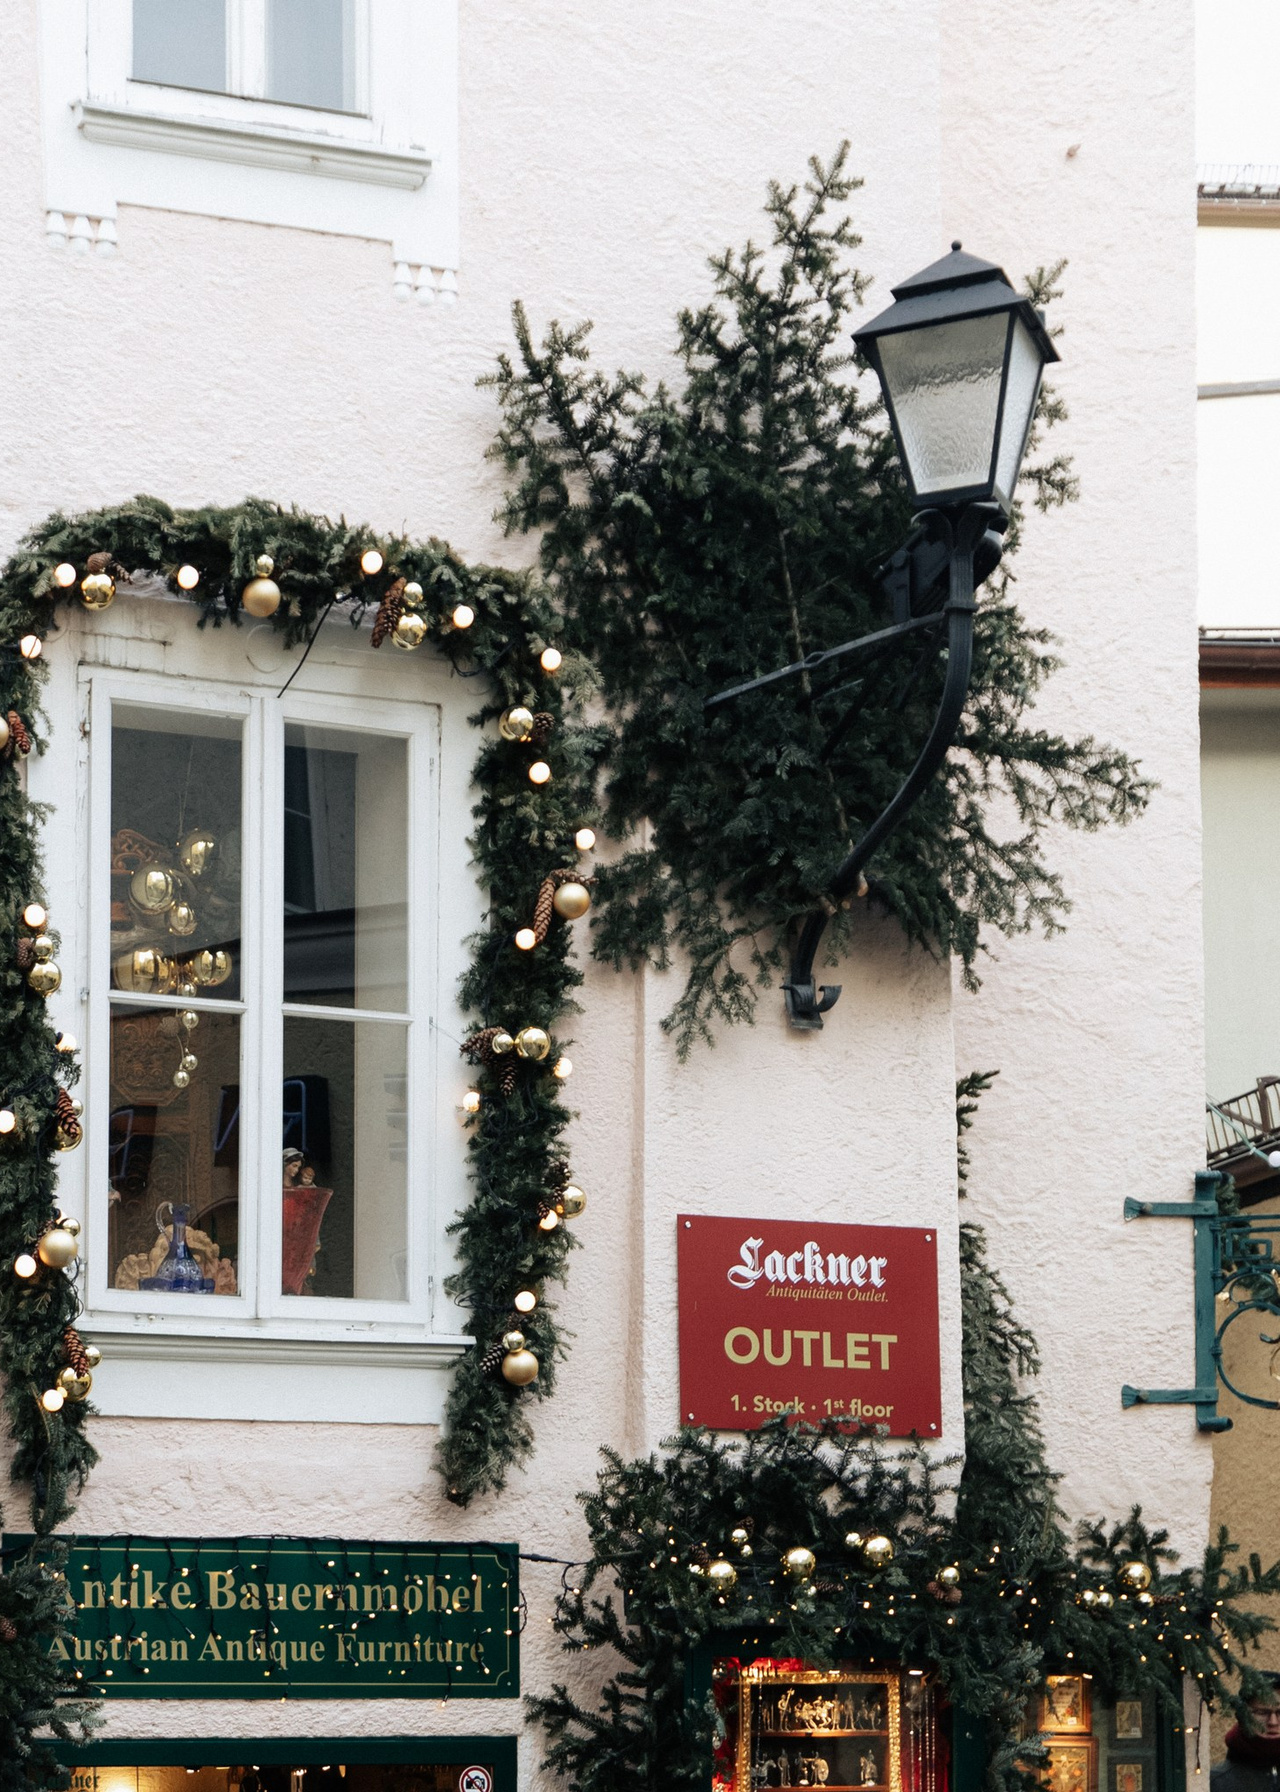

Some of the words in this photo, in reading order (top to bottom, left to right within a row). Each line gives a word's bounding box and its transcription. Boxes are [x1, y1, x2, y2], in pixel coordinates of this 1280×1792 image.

[727, 1237, 888, 1289] Lackner
[766, 1284, 843, 1301] Antiquitäten
[847, 1288, 889, 1303] Outlet.
[724, 1326, 898, 1370] OUTLET
[730, 1395, 747, 1412] 1.
[753, 1395, 805, 1414] Stock
[823, 1400, 844, 1416] 1st
[850, 1398, 894, 1418] floor
[205, 1571, 484, 1613] Bauernmöbel
[48, 1631, 189, 1661] Austrian
[199, 1632, 325, 1670] Antique
[336, 1633, 485, 1663] Furniture
